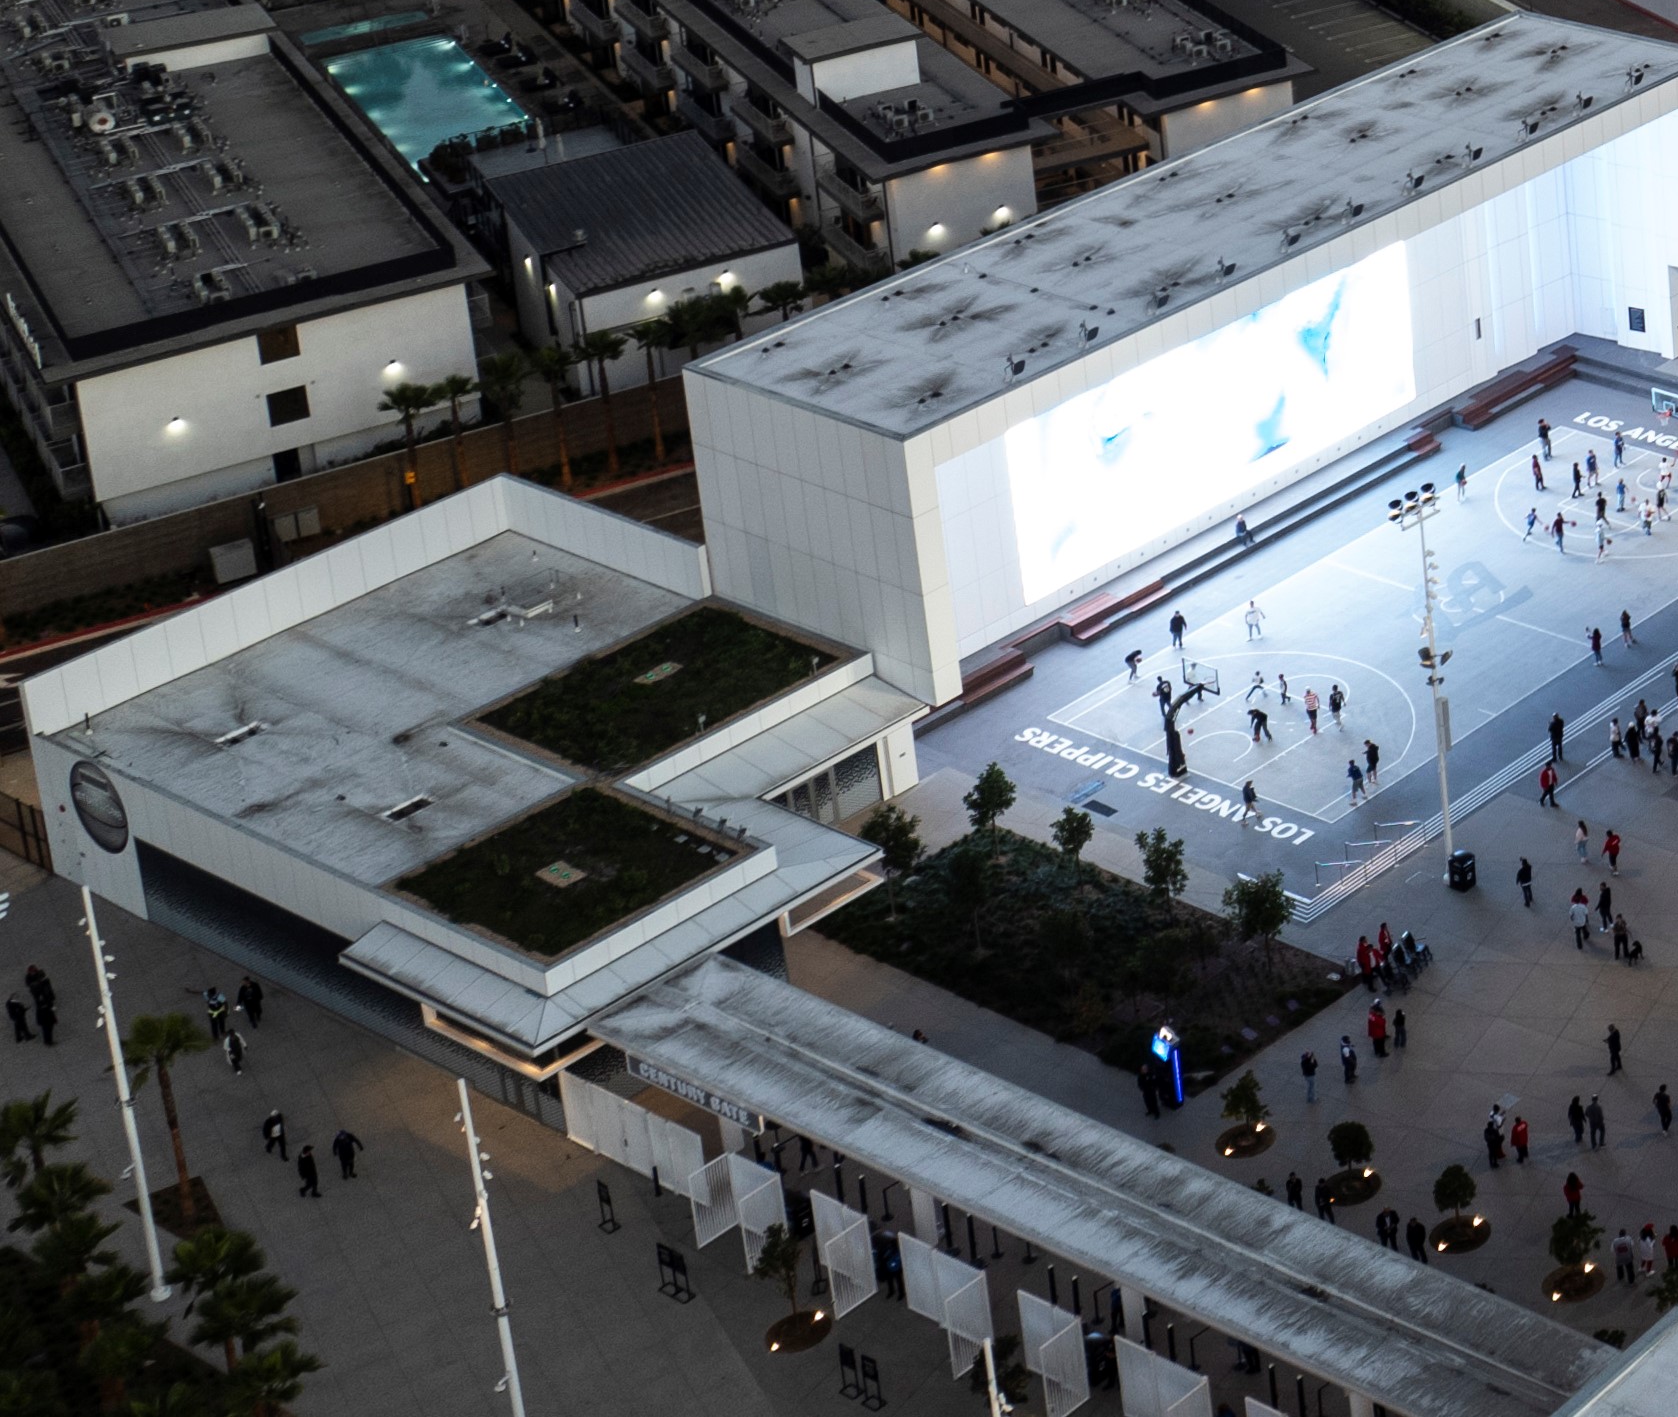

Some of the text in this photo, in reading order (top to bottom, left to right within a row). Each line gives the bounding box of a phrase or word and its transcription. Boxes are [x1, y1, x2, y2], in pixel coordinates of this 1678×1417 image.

[1573, 411, 1625, 432] LOS
[1014, 727, 1315, 846] LOS ANGELES CLIPPERS
[638, 1062, 750, 1126] CENTURY GATE
